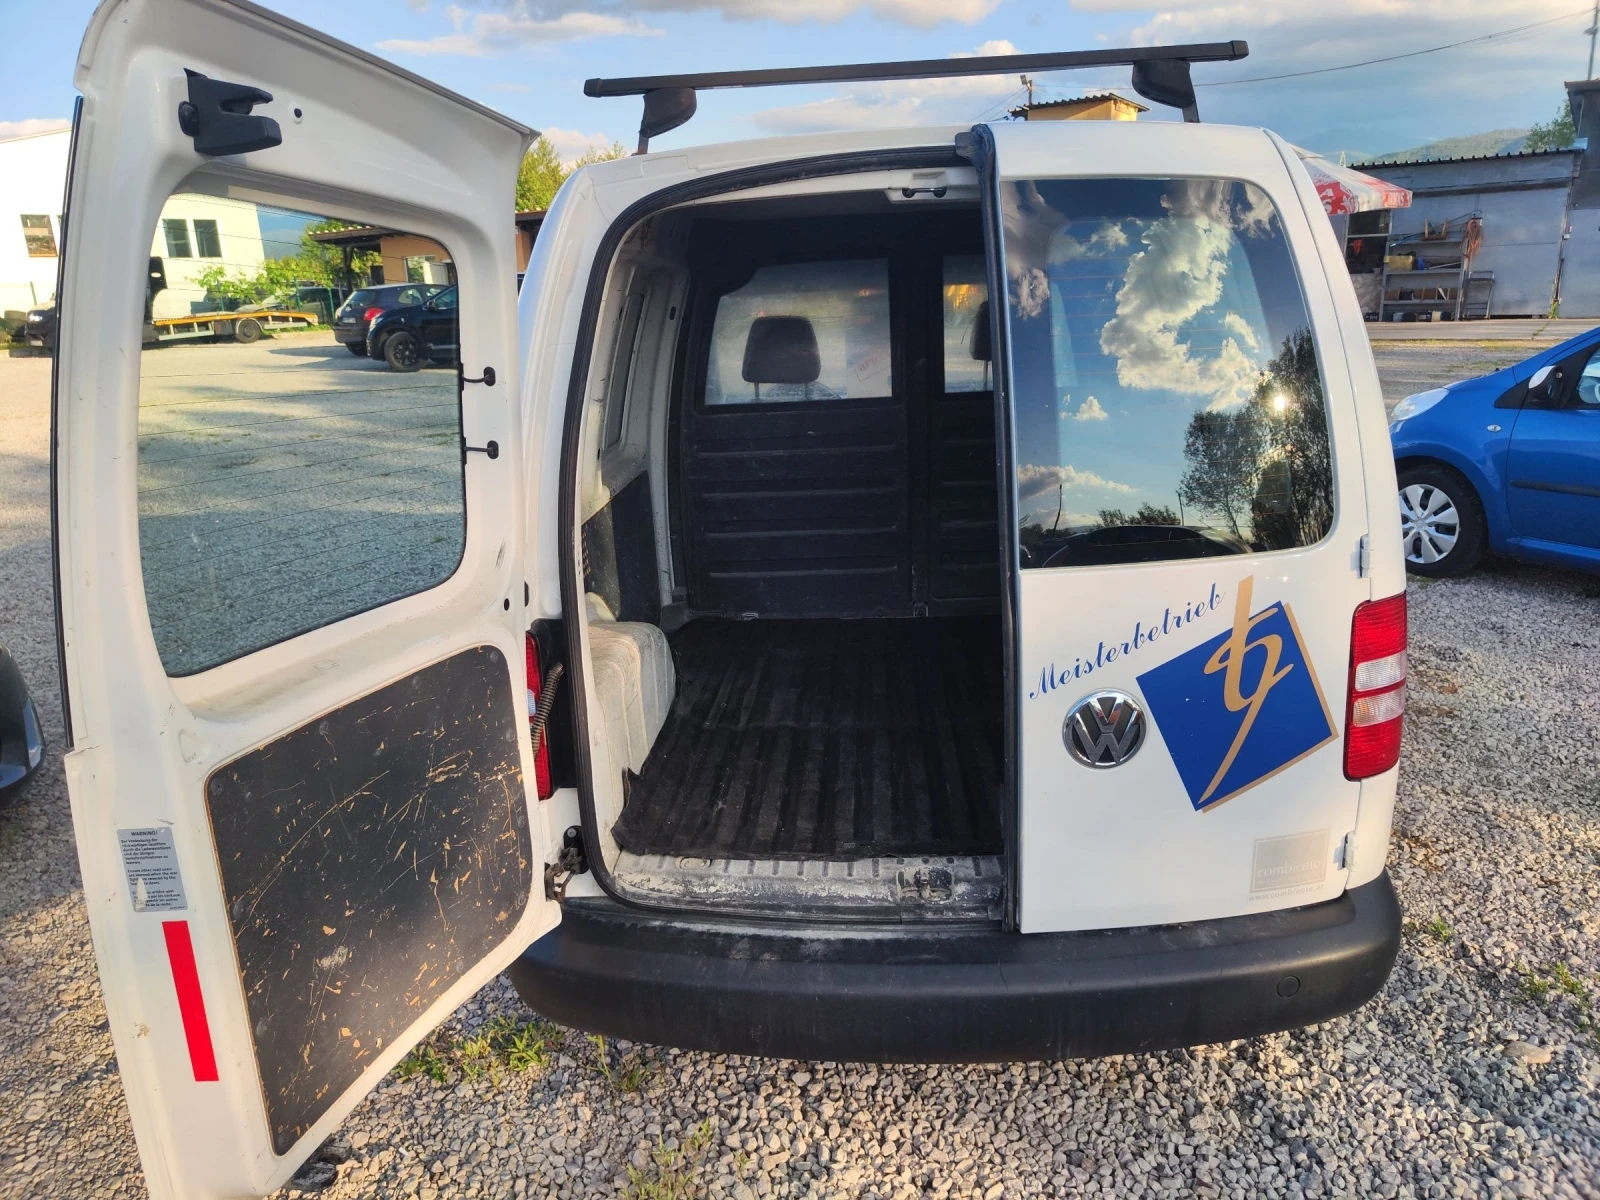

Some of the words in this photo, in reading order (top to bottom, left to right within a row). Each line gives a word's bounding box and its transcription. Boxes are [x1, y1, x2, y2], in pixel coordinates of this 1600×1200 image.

[1029, 582, 1227, 700] Meisterbetrieb
[1257, 858, 1322, 878] combiente
[1248, 884, 1324, 901] www.combiente.at
